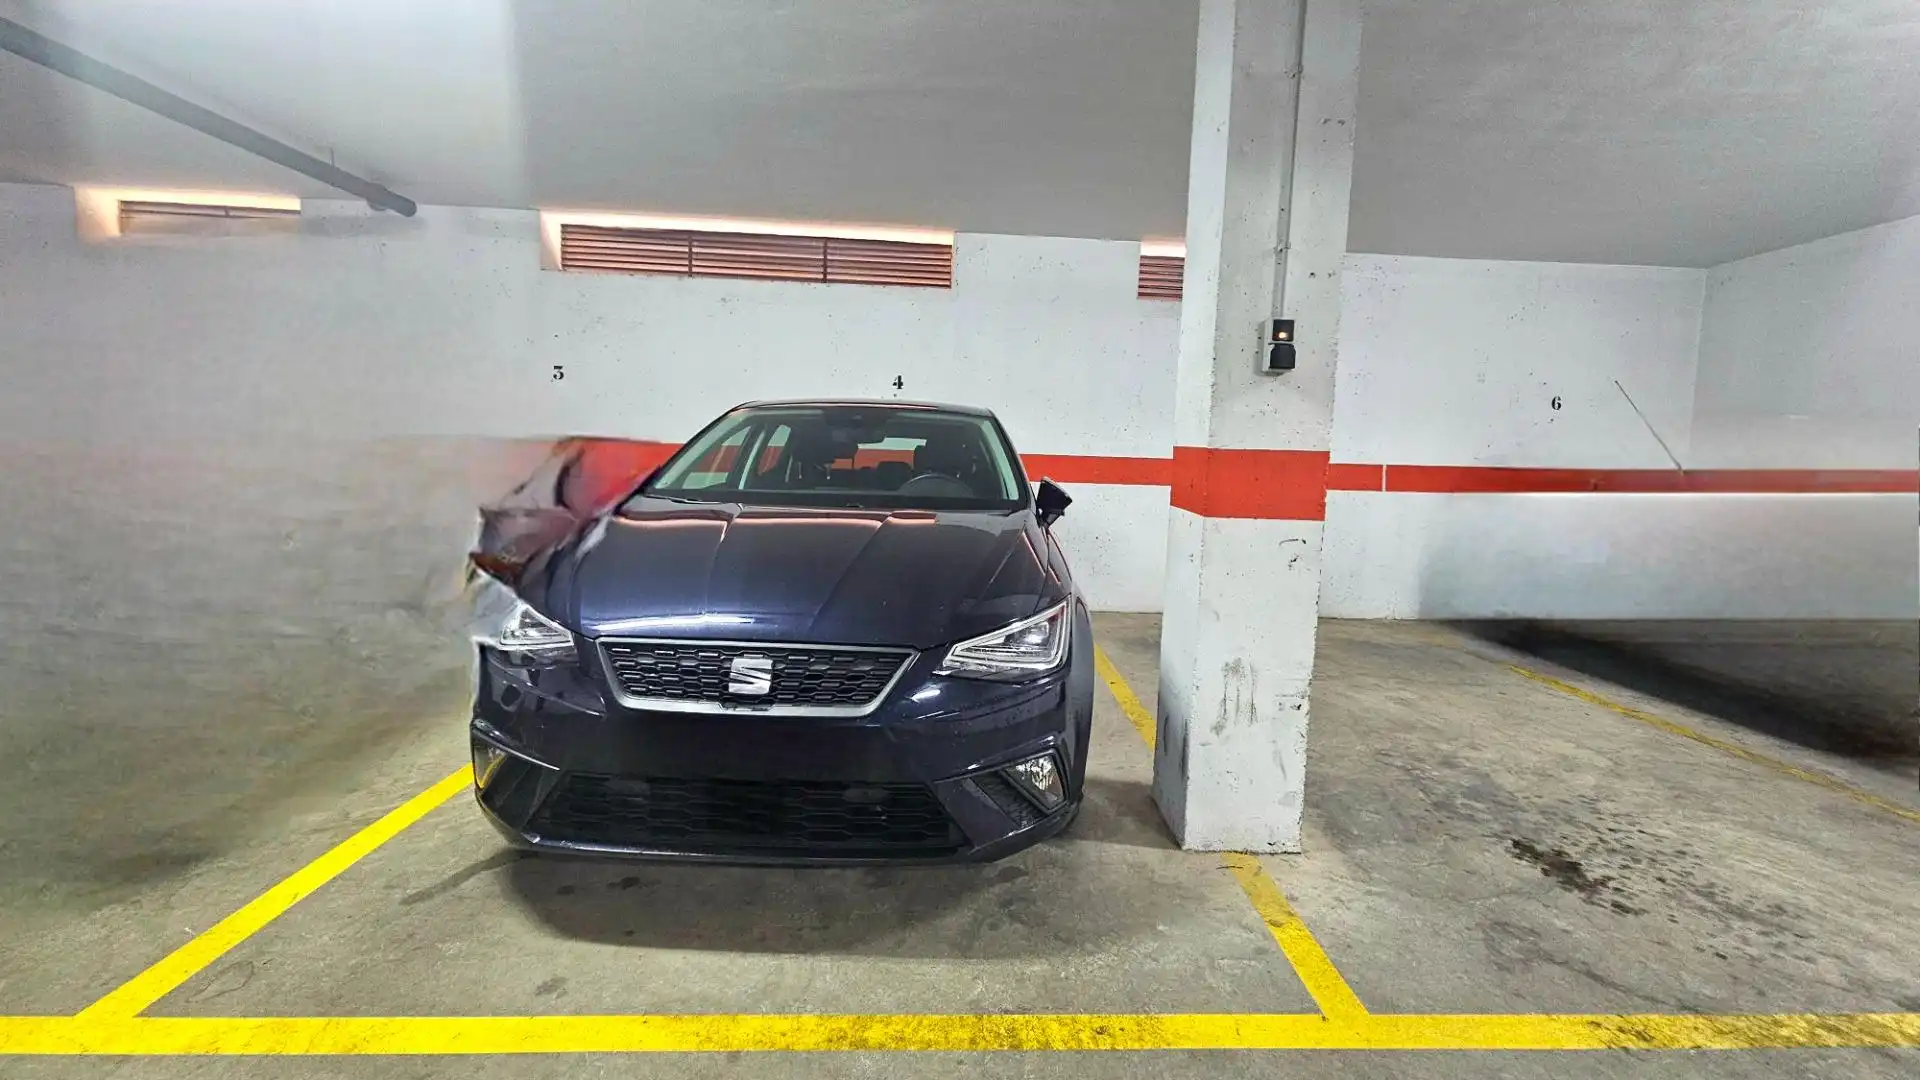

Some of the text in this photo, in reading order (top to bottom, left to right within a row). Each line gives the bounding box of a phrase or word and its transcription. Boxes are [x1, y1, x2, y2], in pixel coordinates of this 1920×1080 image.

[552, 365, 565, 380] 3
[892, 375, 904, 390] 4
[1551, 396, 1562, 411] 6
